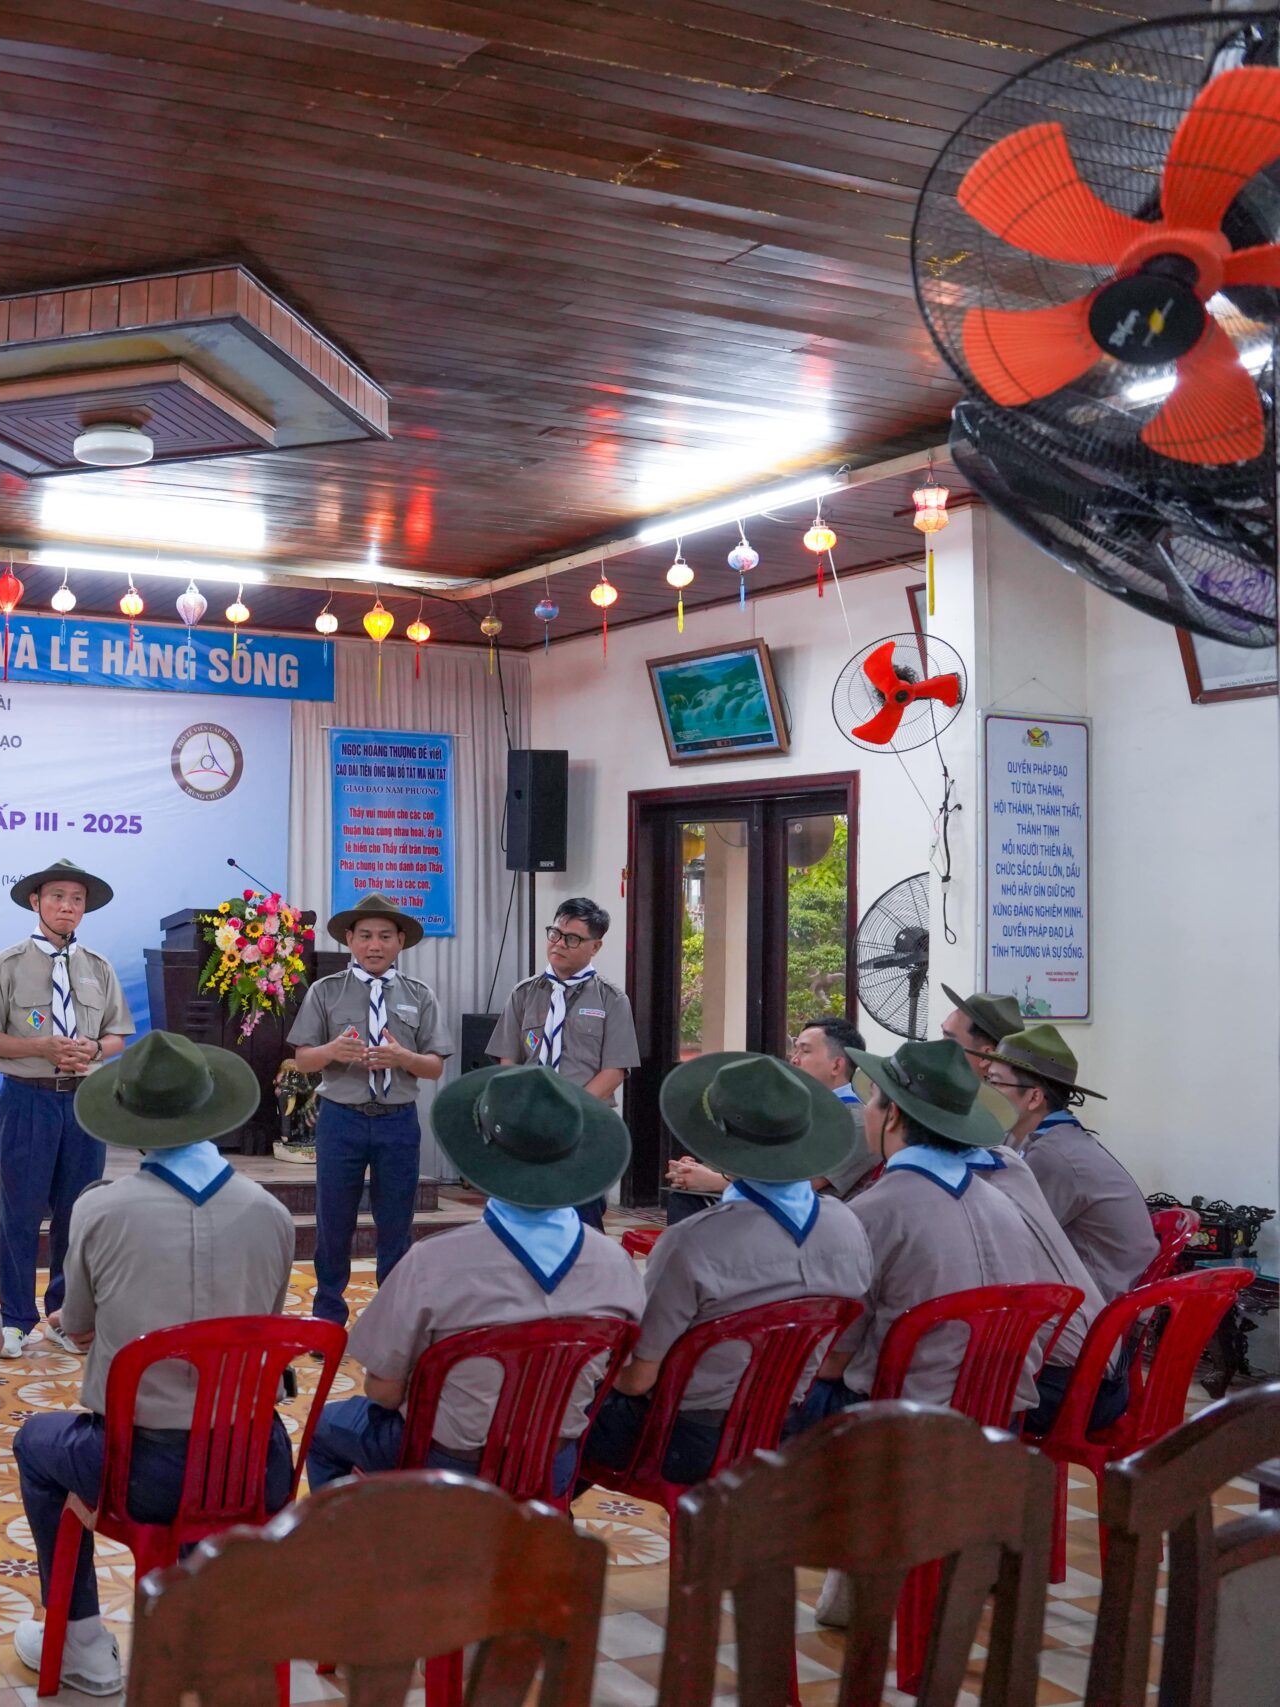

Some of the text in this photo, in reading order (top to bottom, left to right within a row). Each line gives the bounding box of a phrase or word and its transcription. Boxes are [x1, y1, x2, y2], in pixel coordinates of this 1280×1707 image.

[50, 631, 89, 673] LẼ
[102, 628, 197, 681] HẰNG
[208, 638, 299, 688] SỐNG
[341, 744, 362, 759] NGỌC
[363, 743, 387, 757] HOÀNG
[1053, 765, 1067, 779] ĐẠO
[994, 799, 1006, 816] HỘI
[35, 812, 58, 831] III
[83, 813, 143, 834] 2025
[1040, 843, 1061, 856] THIÊN
[1061, 886, 1075, 898] CHO
[1064, 906, 1083, 918] MINH.
[1049, 926, 1063, 940] ĐẠO
[1010, 945, 1040, 958] THƯƠNG
[1041, 944, 1051, 958] VÀ
[1052, 945, 1062, 960] SỰ
[1063, 943, 1084, 959] SỐNG.
